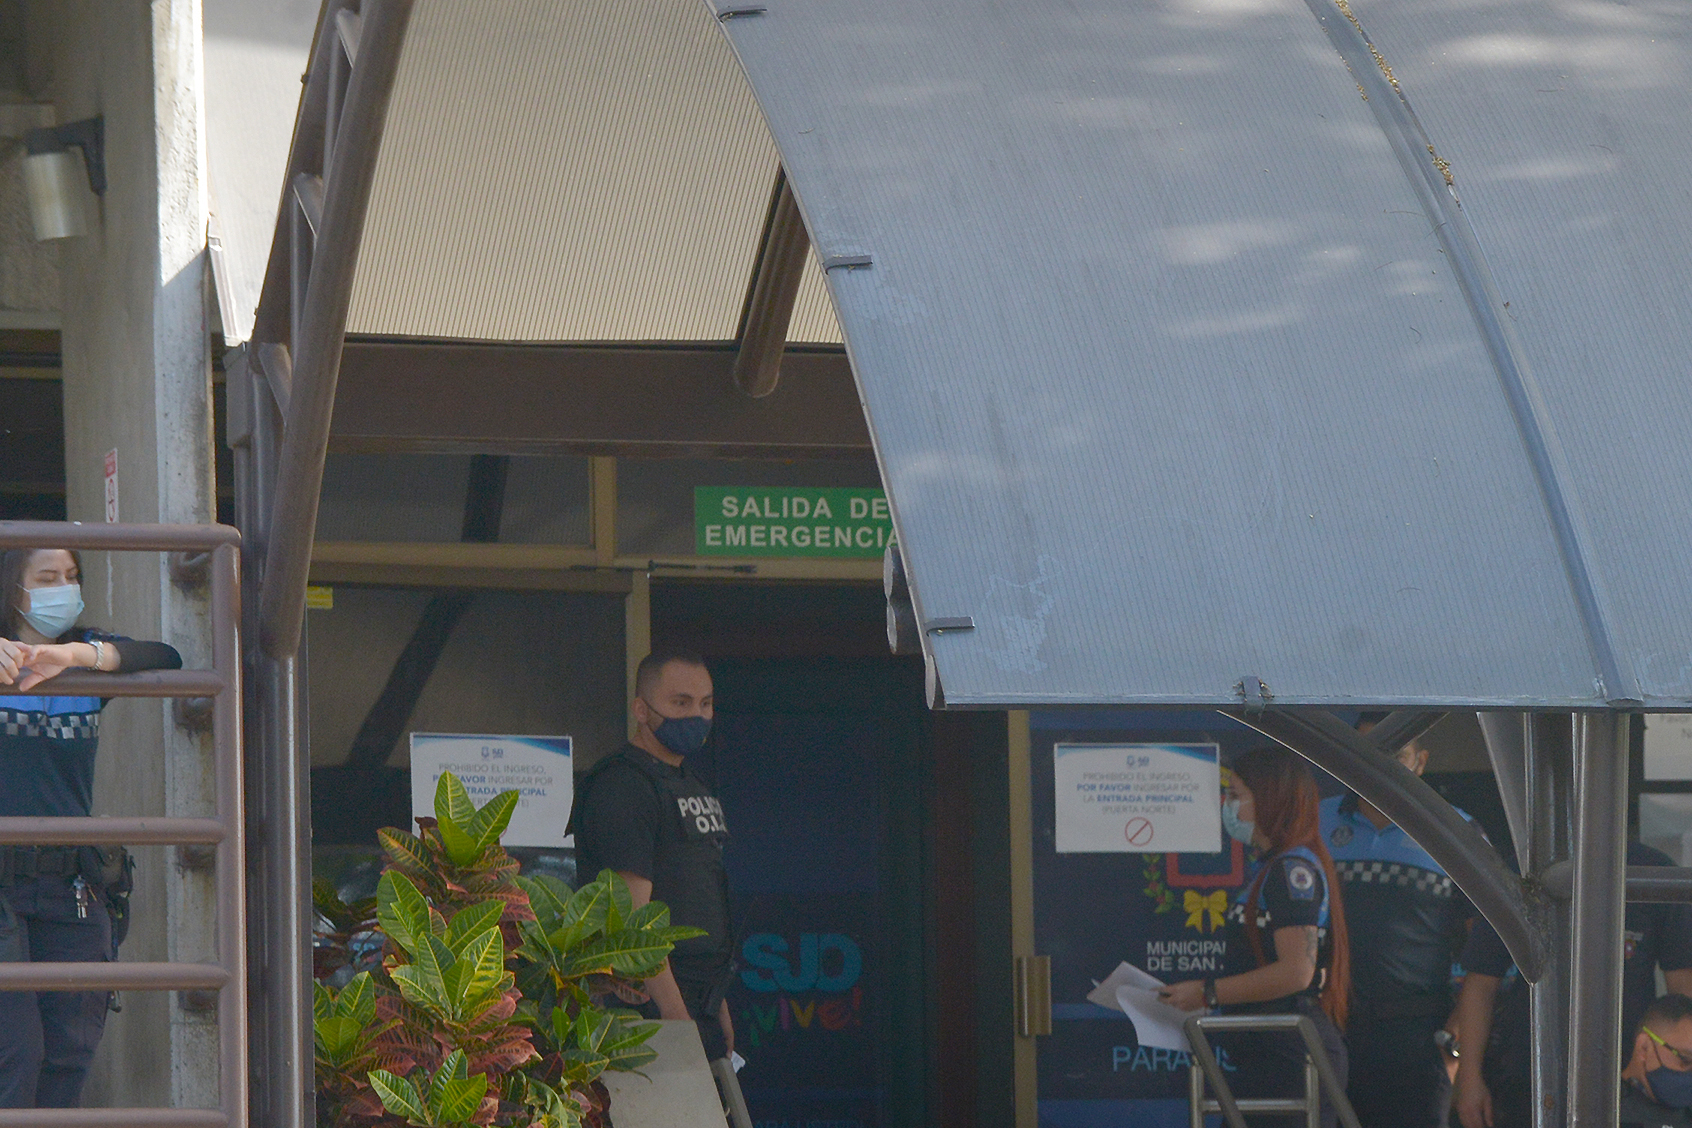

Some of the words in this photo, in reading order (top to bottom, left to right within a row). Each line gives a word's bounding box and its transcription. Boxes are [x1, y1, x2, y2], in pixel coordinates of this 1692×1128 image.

[721, 496, 832, 519] SALIDA
[850, 497, 889, 519] DE
[704, 524, 899, 548] EMERGENCIA
[1076, 783, 1097, 792] POR
[1099, 783, 1131, 792] FAVOR
[1097, 794, 1142, 803] ENTRADA
[1147, 956, 1173, 971] DE
[1177, 956, 1217, 971] SAN
